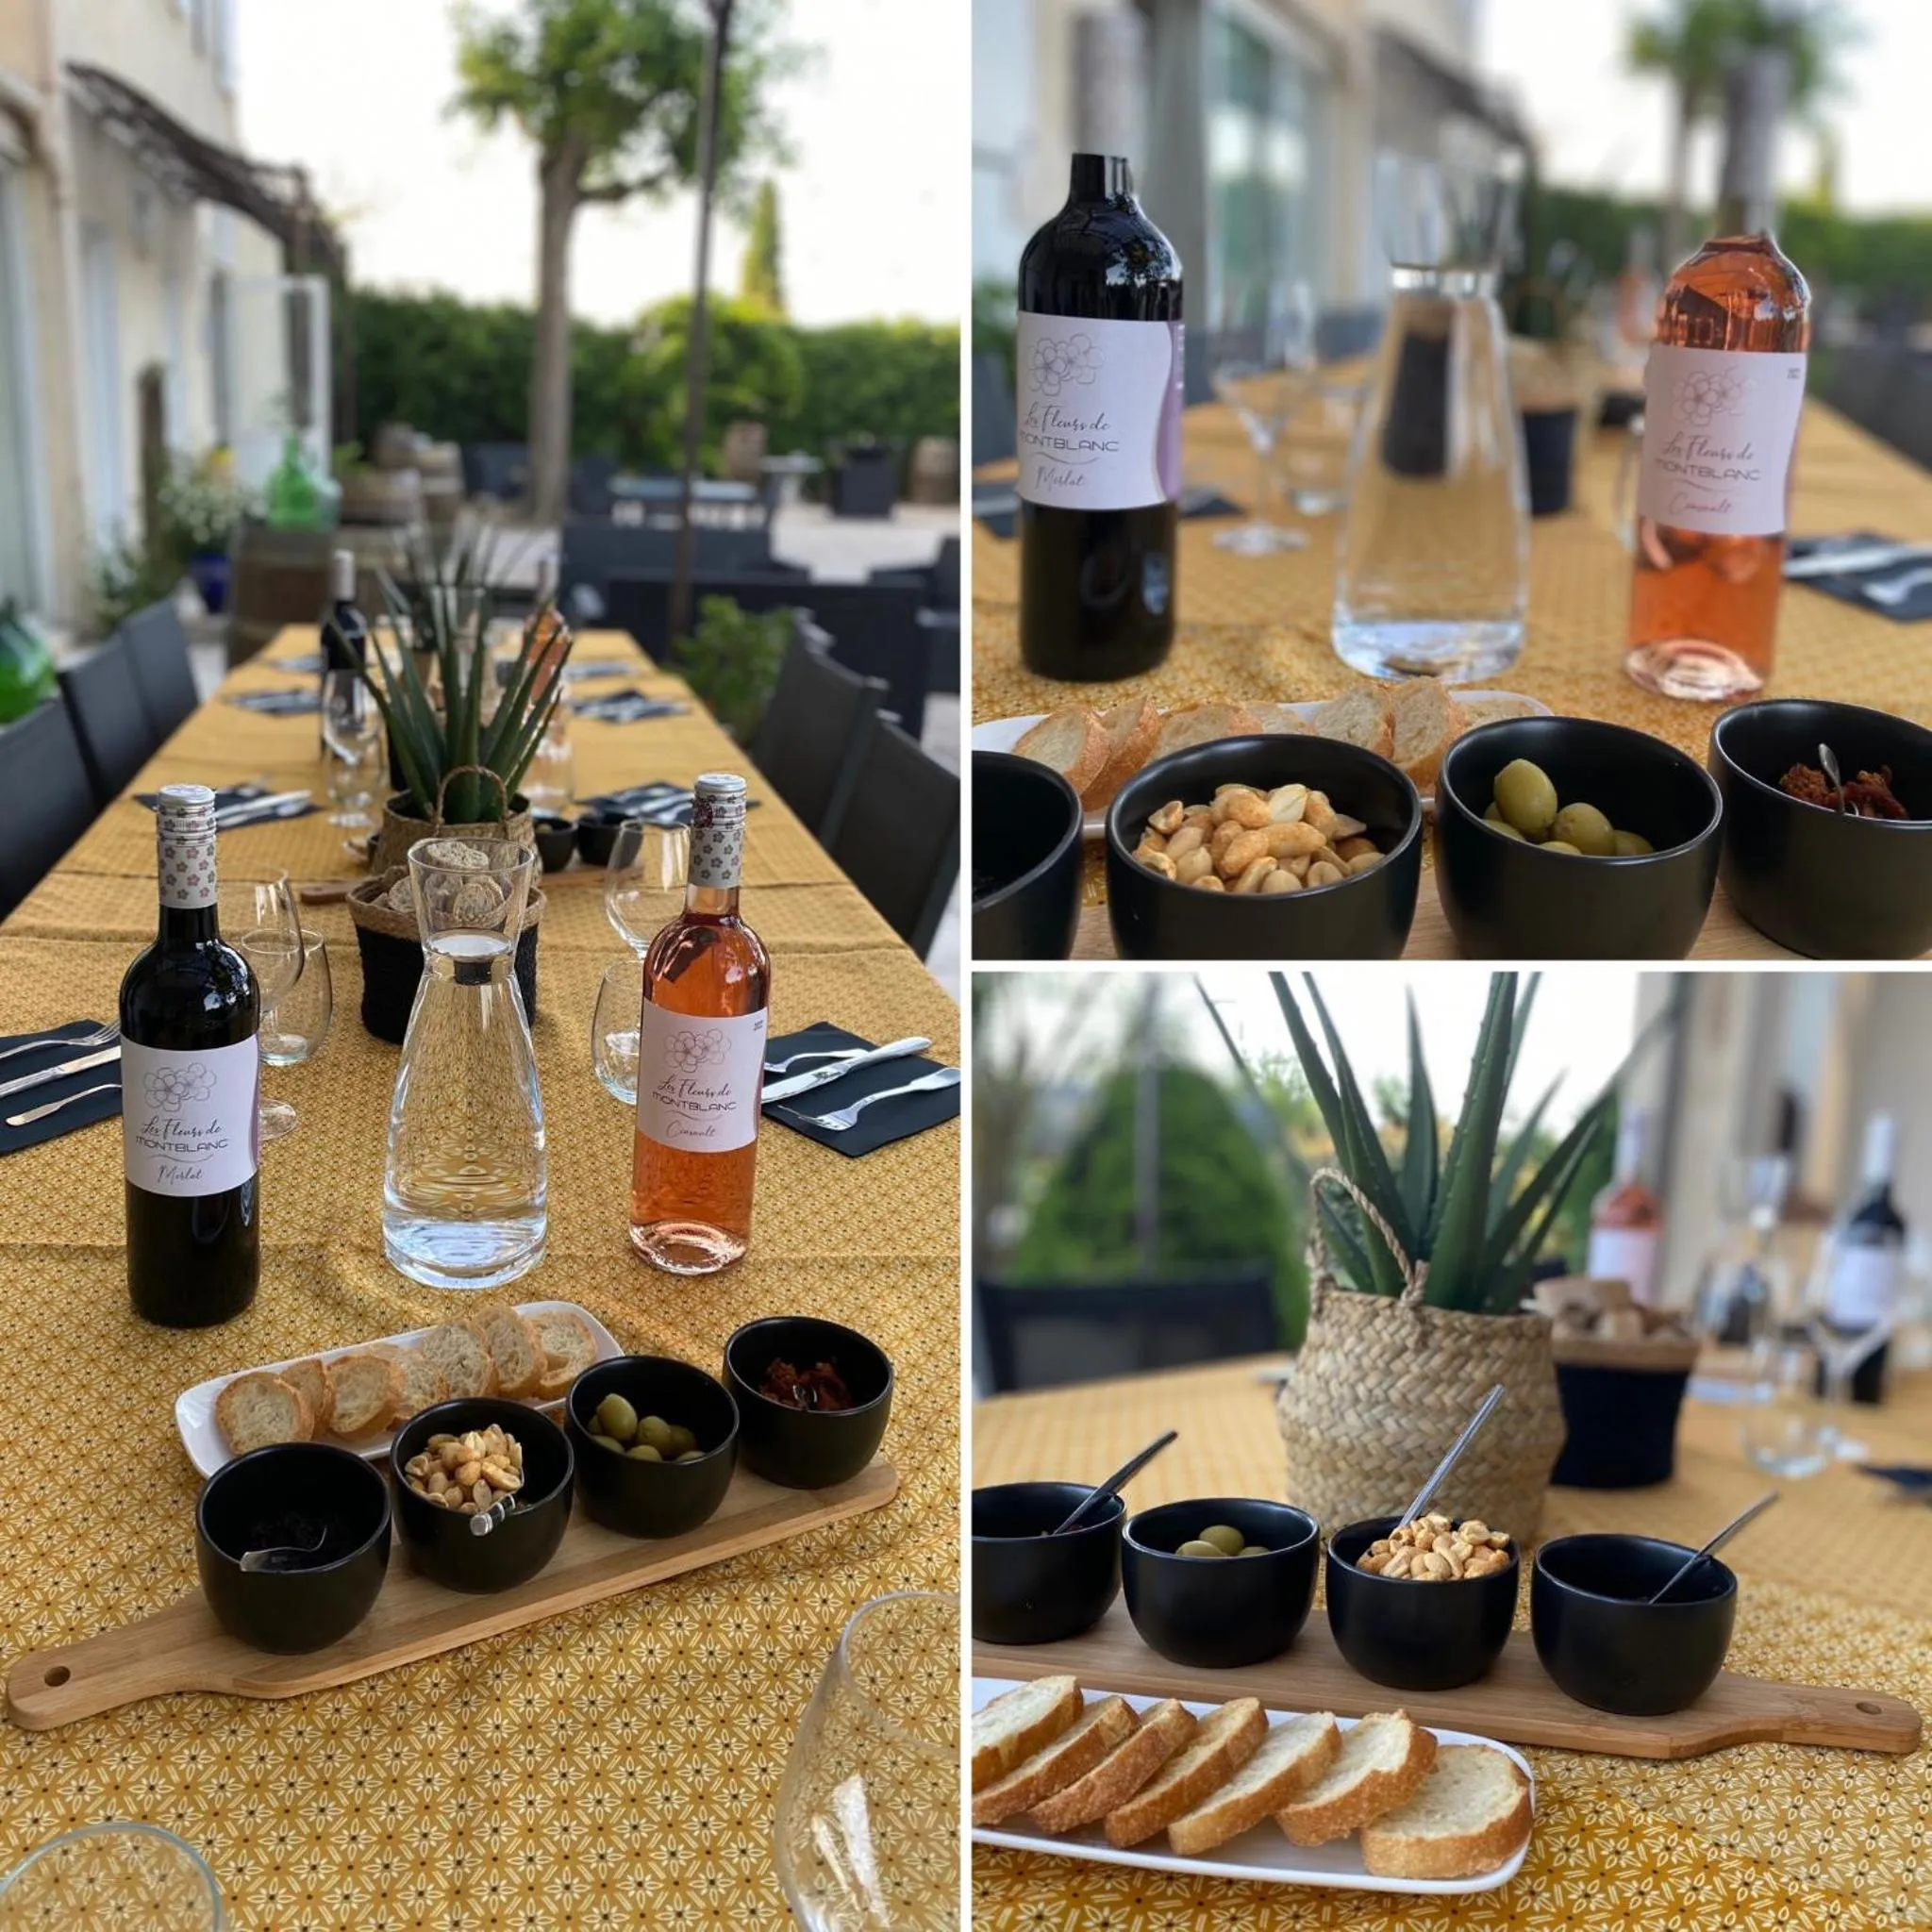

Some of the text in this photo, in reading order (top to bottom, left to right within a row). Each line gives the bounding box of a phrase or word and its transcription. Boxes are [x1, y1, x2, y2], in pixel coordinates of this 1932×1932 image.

[1089, 412, 1111, 430] de
[716, 1083, 732, 1096] de
[205, 1120, 222, 1134] de
[136, 1136, 229, 1152] MONTBLANC
